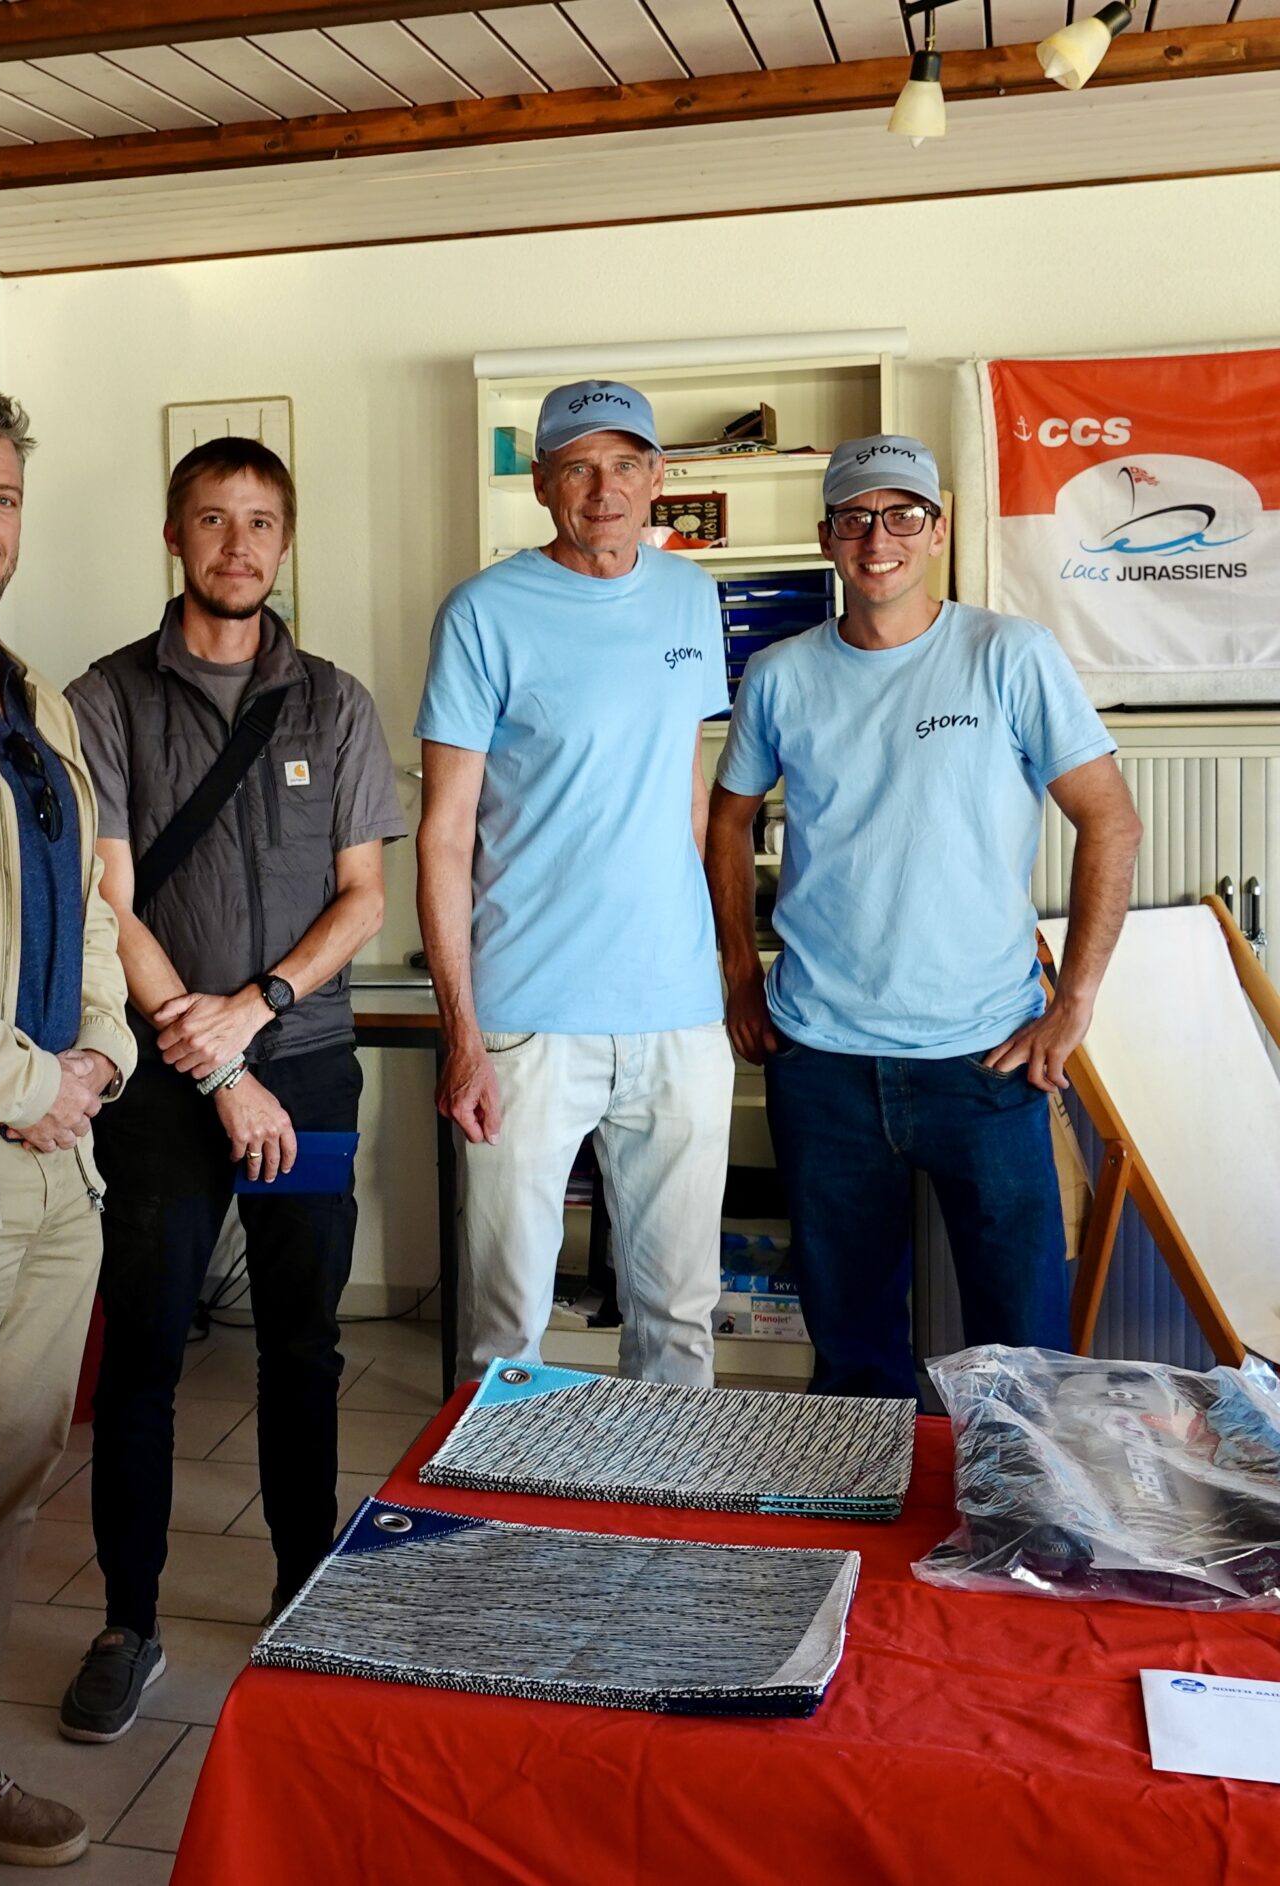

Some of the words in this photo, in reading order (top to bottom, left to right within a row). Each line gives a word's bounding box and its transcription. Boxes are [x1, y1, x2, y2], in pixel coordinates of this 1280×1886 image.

[568, 392, 631, 414] Storm
[1038, 417, 1132, 448] CCS
[856, 445, 917, 465] Storm
[1060, 558, 1110, 582] Lacs
[1116, 563, 1248, 582] JURASSIENS
[664, 647, 703, 670] Storm
[916, 714, 979, 739] Storm
[774, 1281, 791, 1291] SKY
